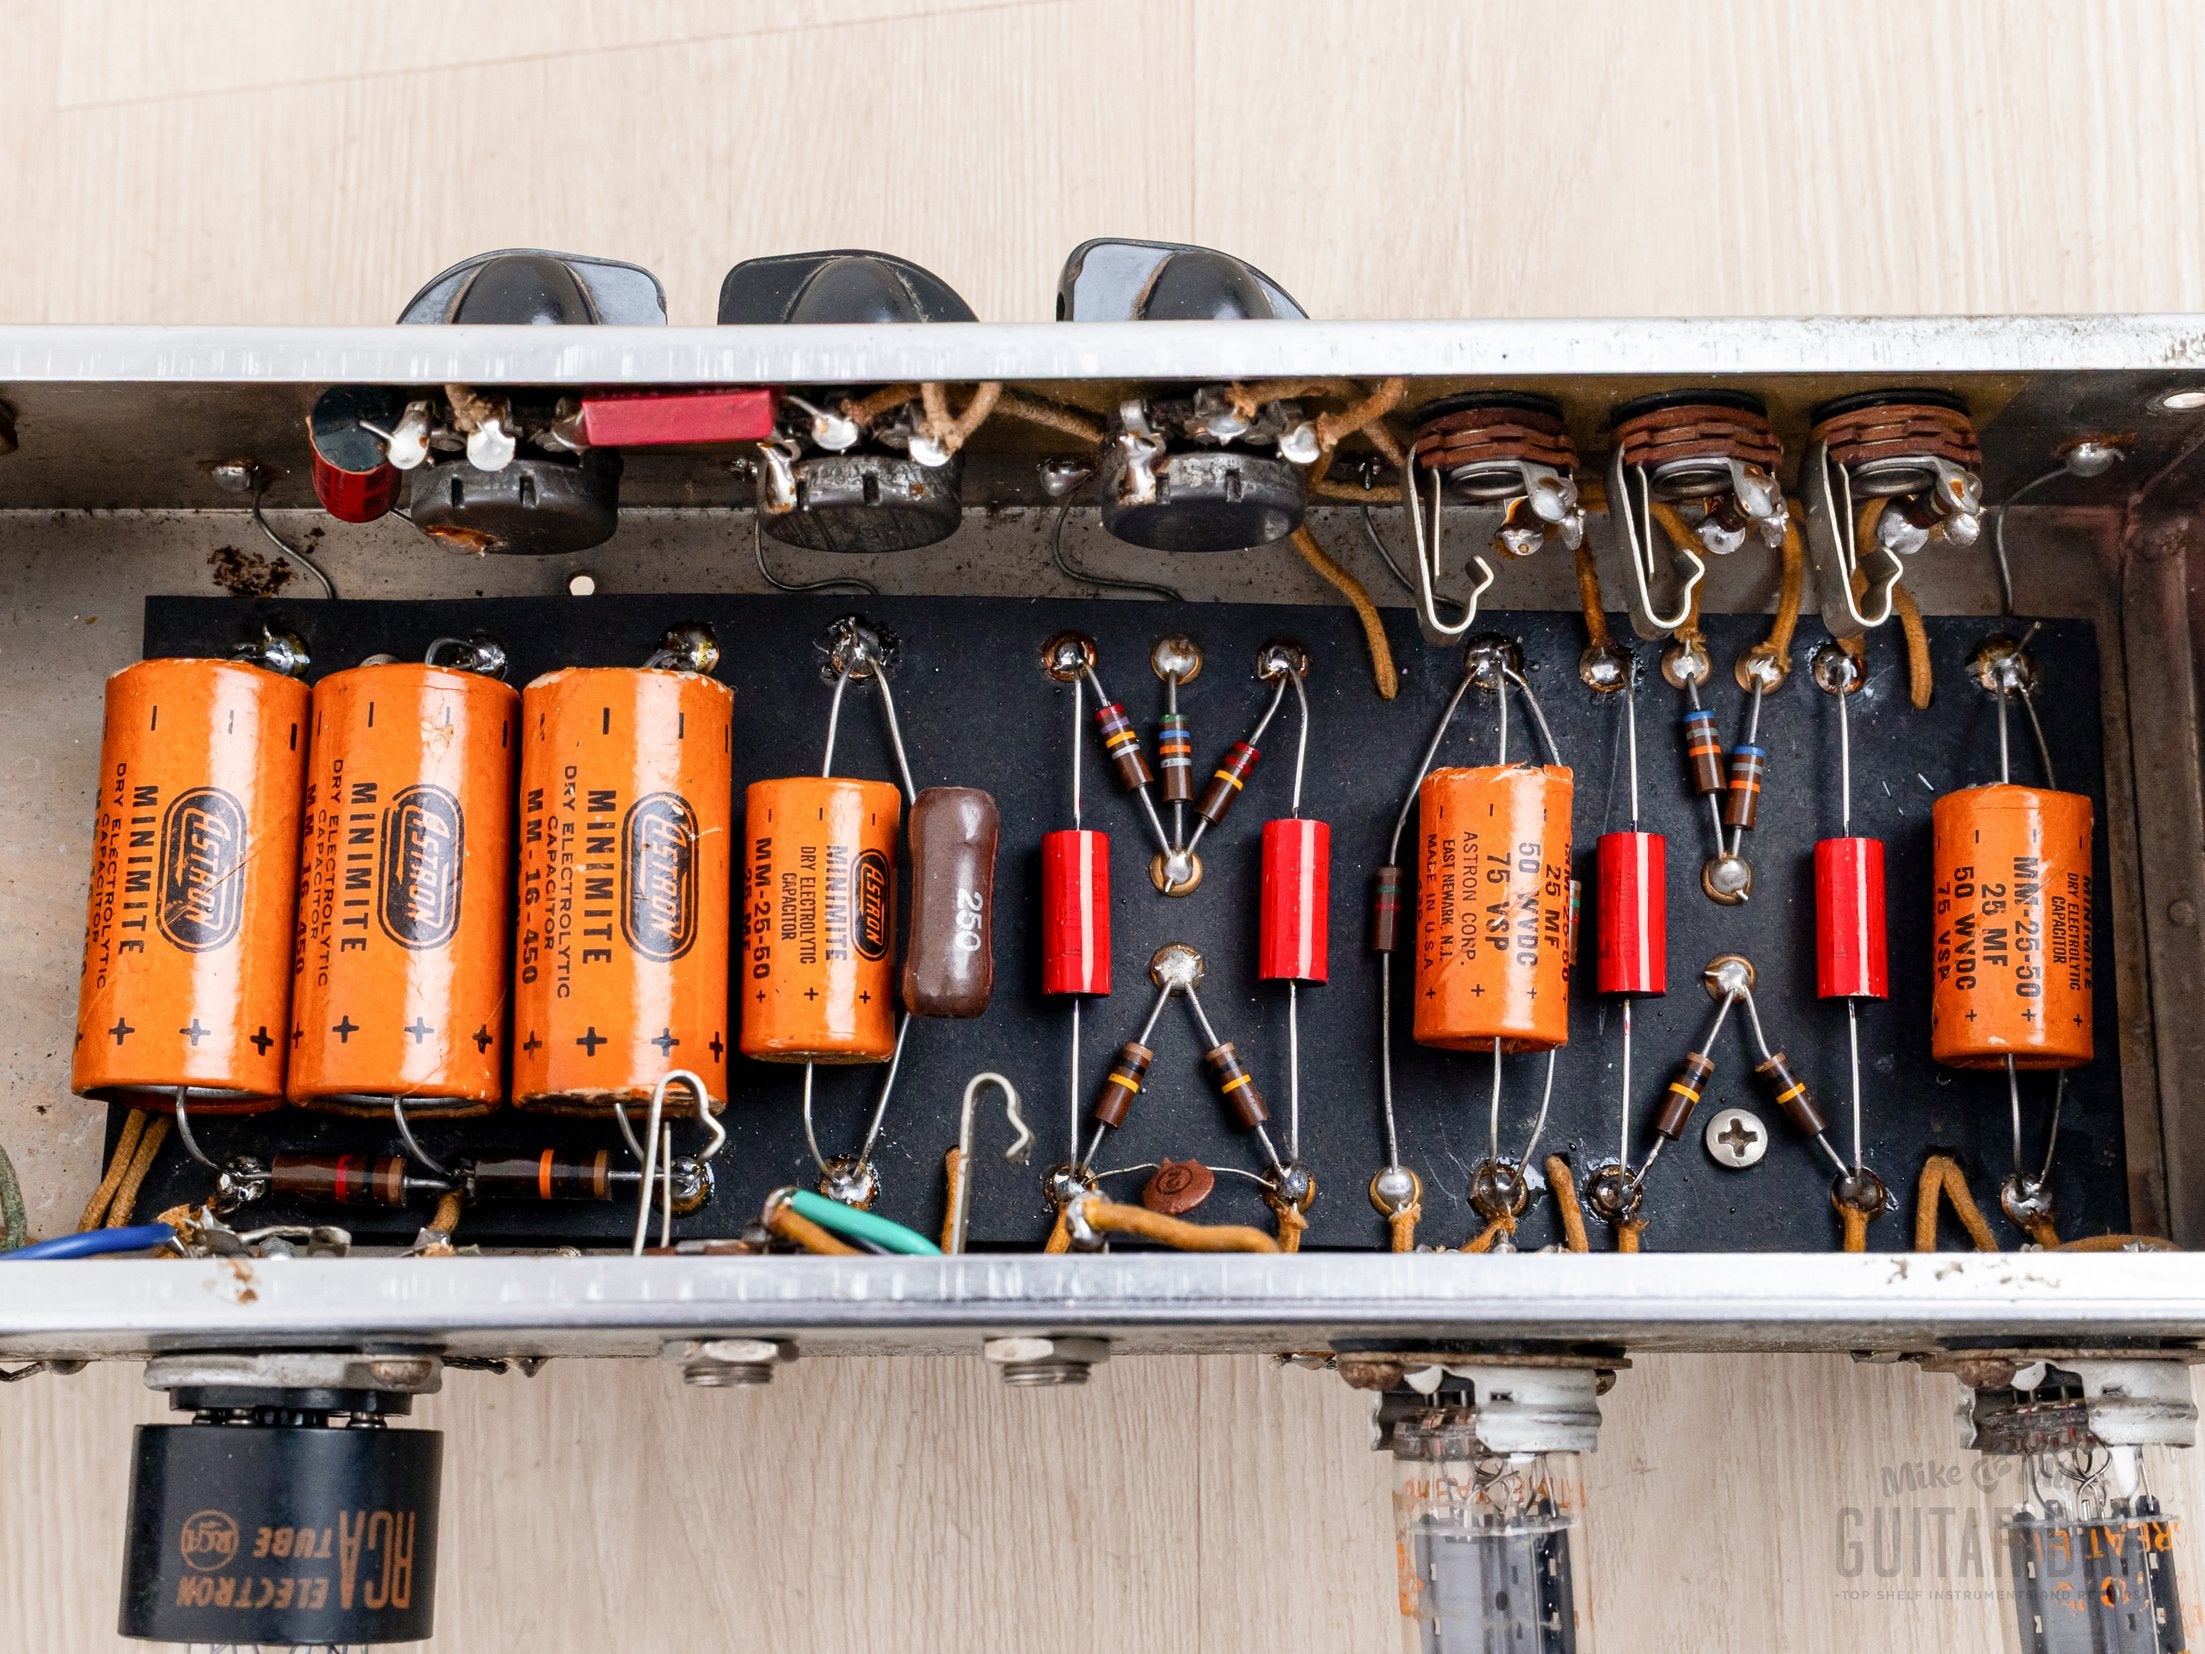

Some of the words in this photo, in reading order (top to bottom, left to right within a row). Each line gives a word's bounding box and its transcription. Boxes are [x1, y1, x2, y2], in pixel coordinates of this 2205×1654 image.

[113, 763, 127, 805] DRY
[329, 759, 344, 804] DRY
[562, 765, 577, 809] DRY
[92, 813, 110, 943] CAPACITOR
[118, 785, 159, 955] MINIMITE
[186, 810, 232, 927] ASTRON
[310, 809, 327, 940] CAPACITOR
[341, 782, 377, 953] MINIMITE
[406, 806, 450, 926] ASTRON
[544, 816, 558, 950] CAPACITOR
[582, 790, 616, 965] MINIMITE
[640, 816, 687, 937] ASTRON
[800, 846, 816, 870] DRY
[1426, 833, 1437, 884] MADE
[1442, 839, 1455, 868] EAST
[1462, 831, 1478, 901] ASTRON
[1486, 853, 1511, 884] 75
[1518, 842, 1540, 873] 50
[1545, 864, 1561, 897] 25
[1954, 866, 1974, 898] 50
[2067, 872, 2079, 897] DRY
[96, 818, 121, 990] ELECTROLYTIC
[318, 815, 339, 986] ELECTROLYTIC
[557, 822, 574, 999] ELECTROLYTIC
[753, 838, 772, 980] MM-25-50
[781, 872, 797, 940] CAPACITOR
[800, 877, 816, 964] ELECTROLYTIC
[824, 845, 849, 961] MINIMITE
[860, 863, 884, 946] ASTRON
[955, 888, 984, 952] 250
[1426, 894, 1435, 911] IN
[1440, 874, 1455, 931] NEWARK,
[1485, 901, 1510, 951] VSP
[1517, 891, 1539, 967] WVDC
[1544, 909, 1560, 949] MF
[1937, 881, 1950, 915] 75
[1981, 883, 2007, 916] 25
[2014, 856, 2041, 998] MM-25-50
[2051, 895, 2067, 964] CAPACITOR
[1460, 913, 1477, 966] CORP.
[1937, 931, 1950, 983] VSP
[1955, 913, 1976, 990] WVDC
[1982, 928, 2008, 967] MF
[2068, 903, 2081, 991] ELECTROLYTIC
[2083, 875, 2092, 990] MINIMITE
[253, 1527, 333, 1558] TUBE
[339, 1510, 416, 1610] RCA
[176, 1576, 331, 1610] ELECTRON
